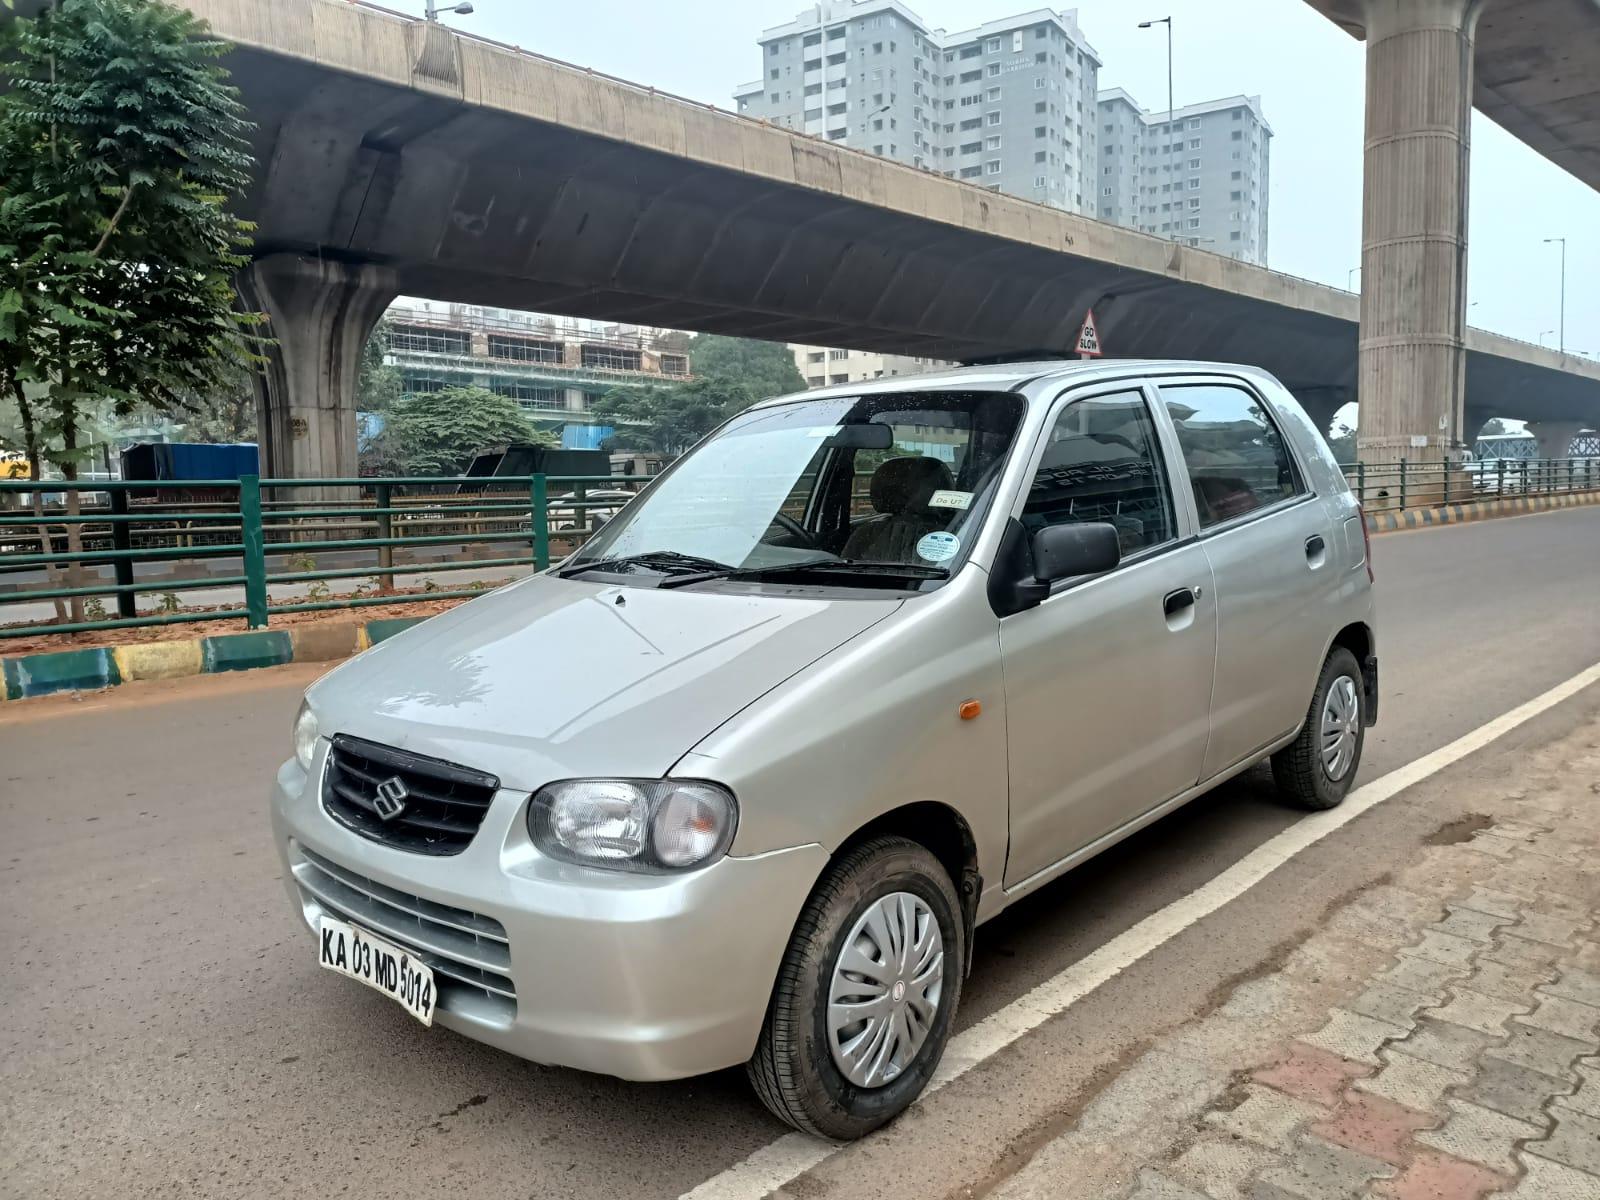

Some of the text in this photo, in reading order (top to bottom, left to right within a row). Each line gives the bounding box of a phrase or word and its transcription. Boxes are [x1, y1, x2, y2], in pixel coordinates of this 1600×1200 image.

[1084, 327, 1094, 337] GO
[1080, 339, 1096, 349] SLOW
[322, 927, 432, 1018] KA 03 MD 5014
